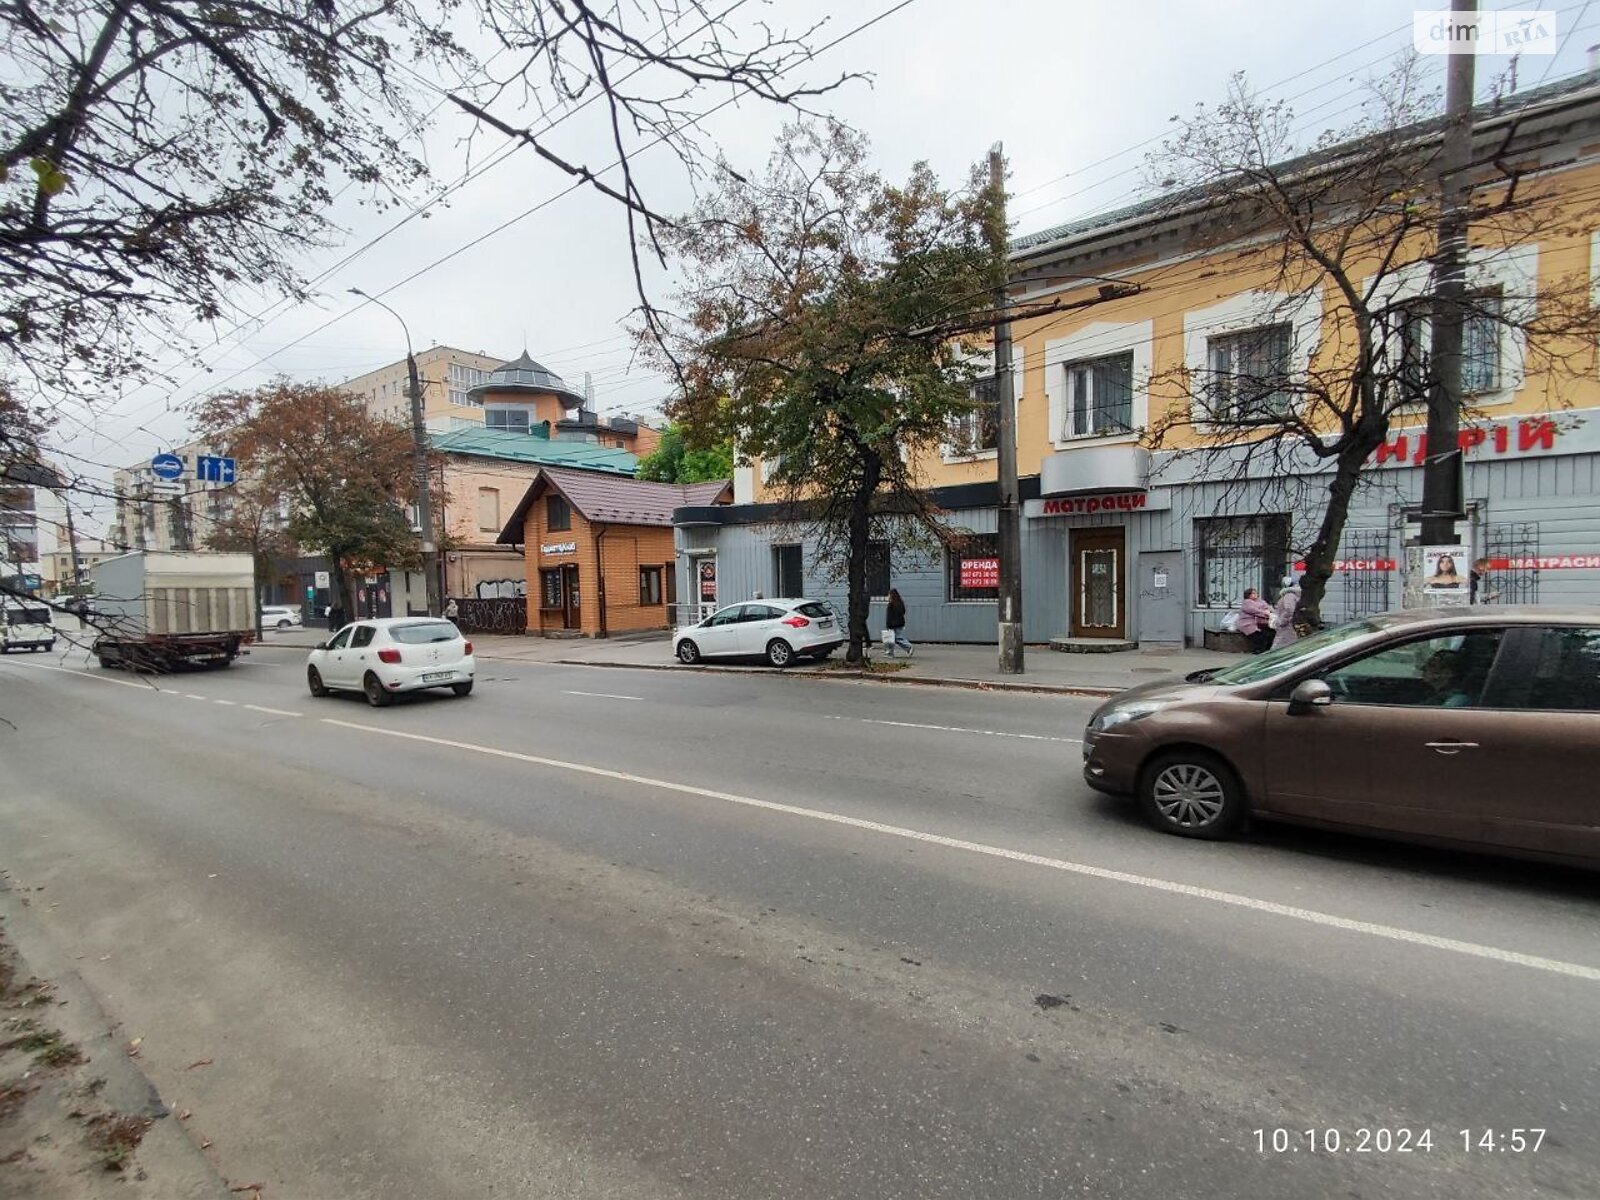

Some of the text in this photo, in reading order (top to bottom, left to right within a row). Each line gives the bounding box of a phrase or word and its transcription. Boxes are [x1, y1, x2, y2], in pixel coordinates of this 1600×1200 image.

[961, 561, 998, 569] ОРЕНДА
[1332, 560, 1376, 570] РАСИ
[1508, 556, 1600, 568] МАТРАСИ
